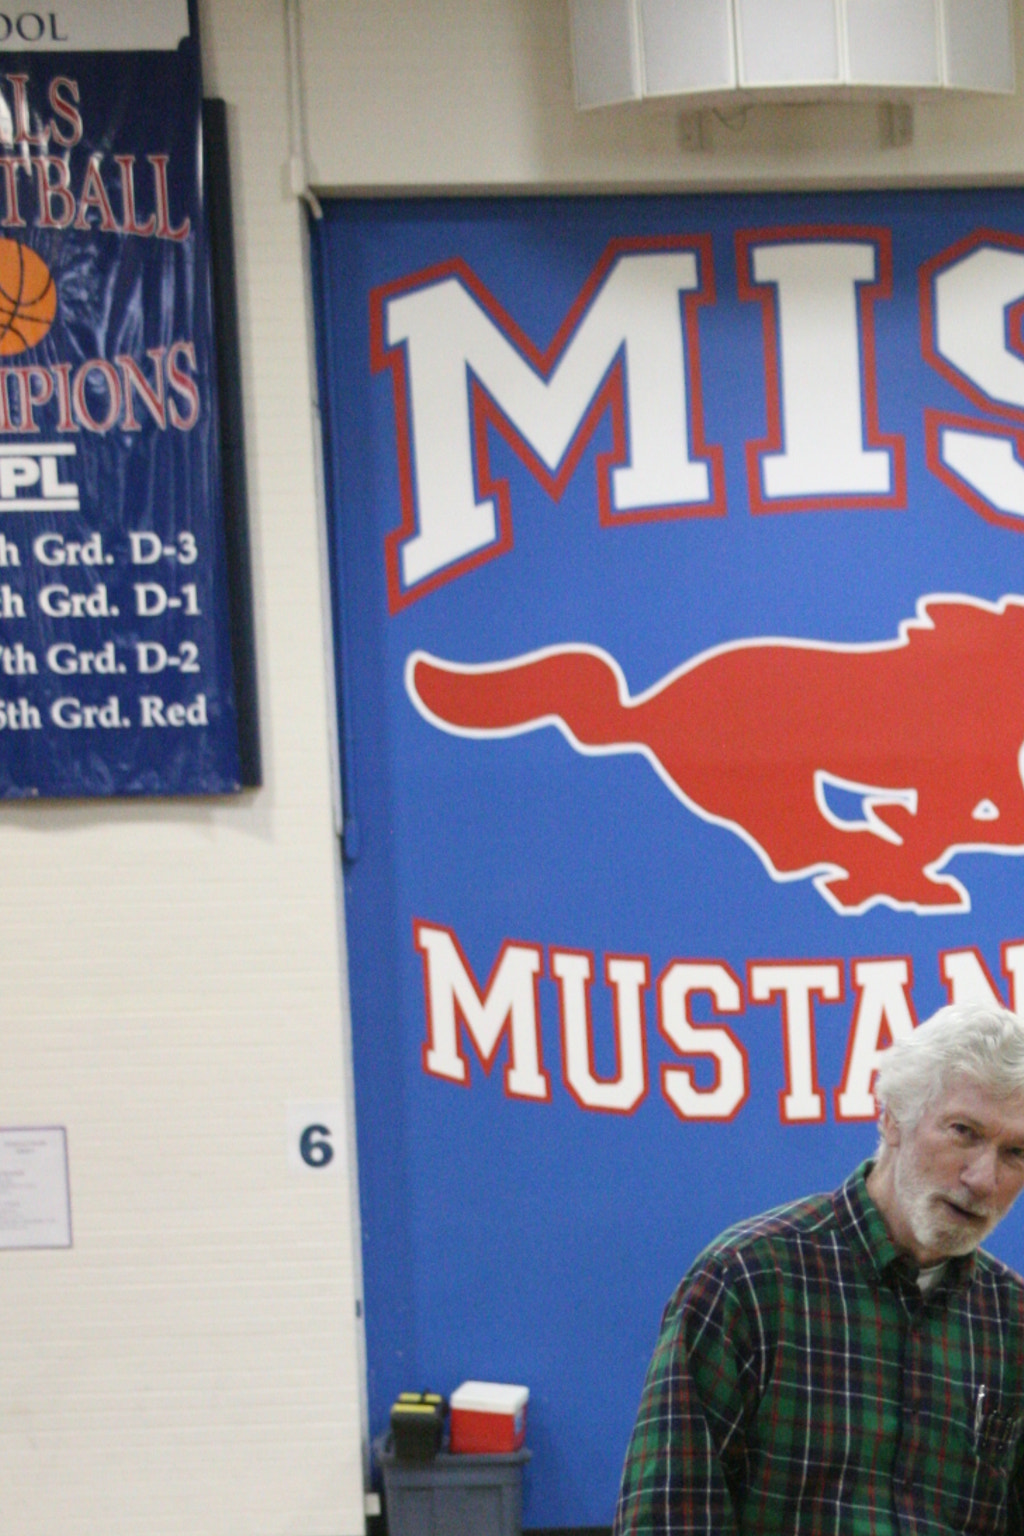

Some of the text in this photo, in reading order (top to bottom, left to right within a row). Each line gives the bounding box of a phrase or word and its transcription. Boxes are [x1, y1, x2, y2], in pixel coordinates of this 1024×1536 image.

[33, 532, 115, 566] Grd.
[129, 531, 198, 565] D-3
[39, 583, 120, 618] Grd.
[135, 582, 201, 617] D-1
[0, 641, 201, 675] th Grd. D-2
[51, 695, 131, 729] Grd.
[141, 694, 209, 727] Red
[299, 1124, 335, 1168] 6
